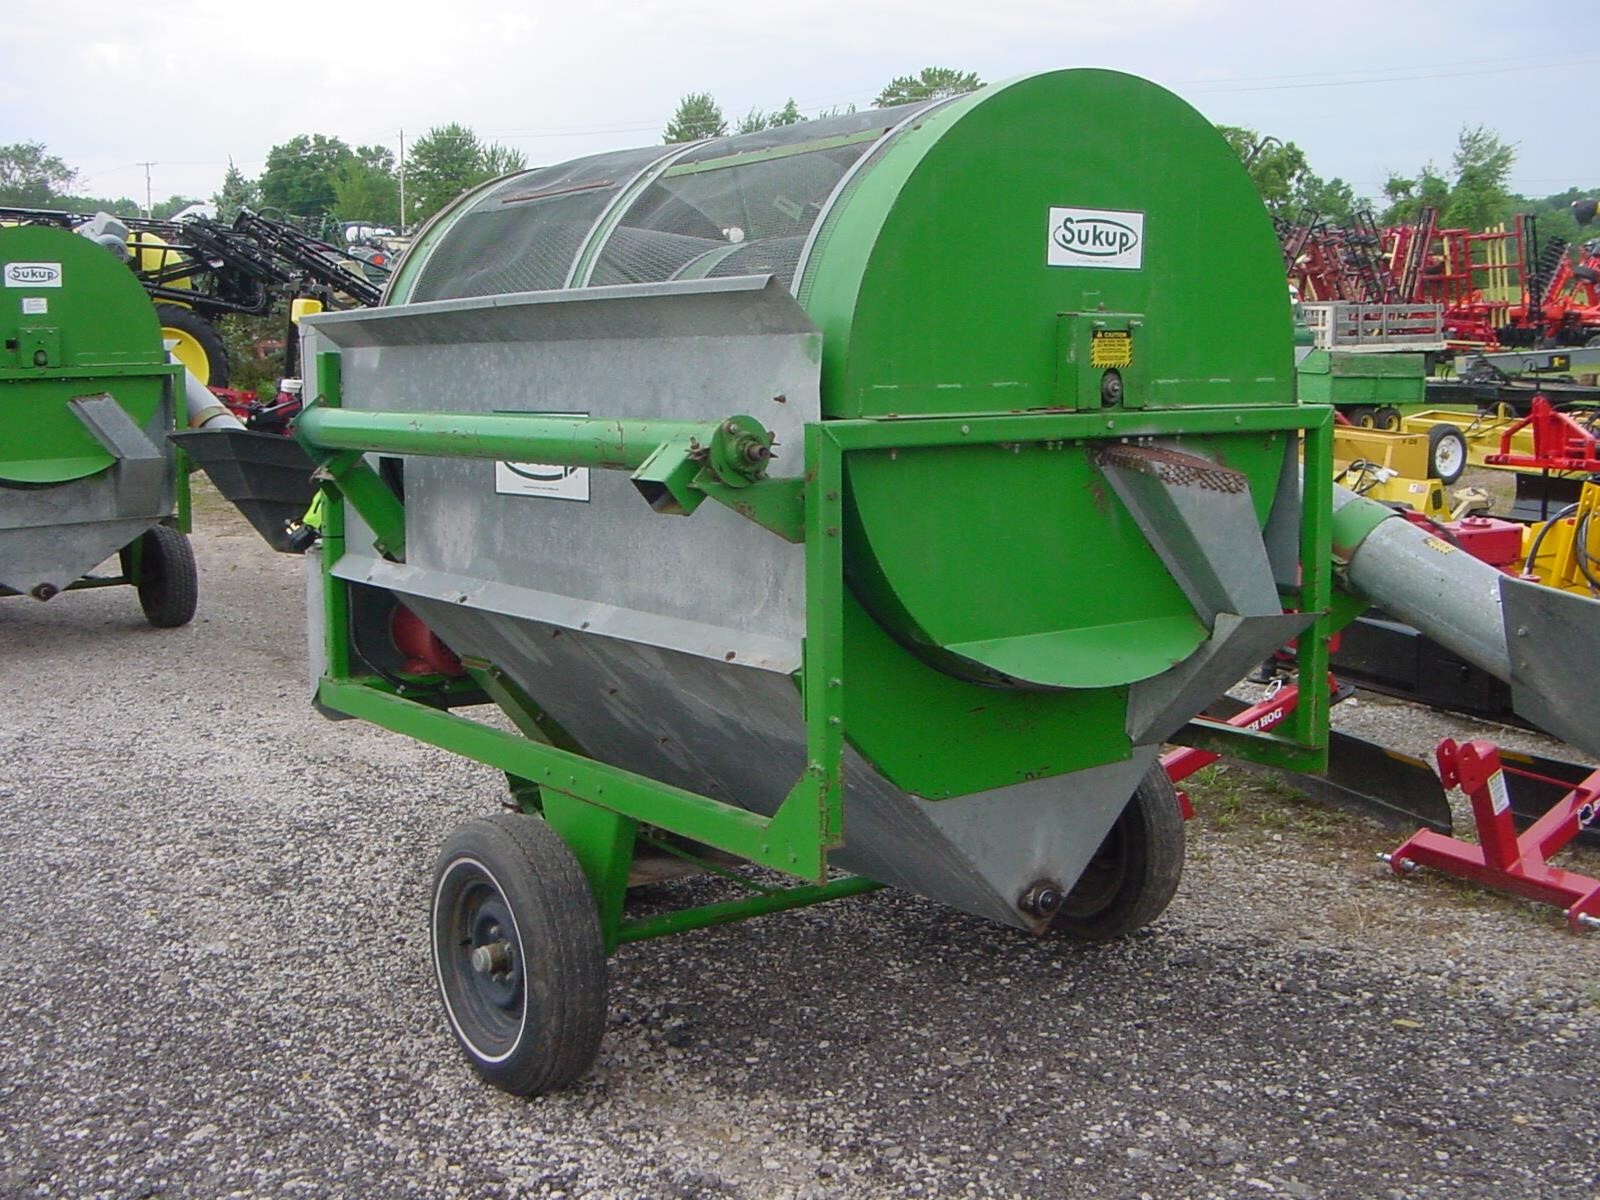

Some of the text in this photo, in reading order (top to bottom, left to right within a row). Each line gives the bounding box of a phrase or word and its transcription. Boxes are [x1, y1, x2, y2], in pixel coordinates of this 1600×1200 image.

[1061, 216, 1130, 255] Sukup
[12, 266, 54, 281] Sukup
[1260, 708, 1282, 728] HOG
